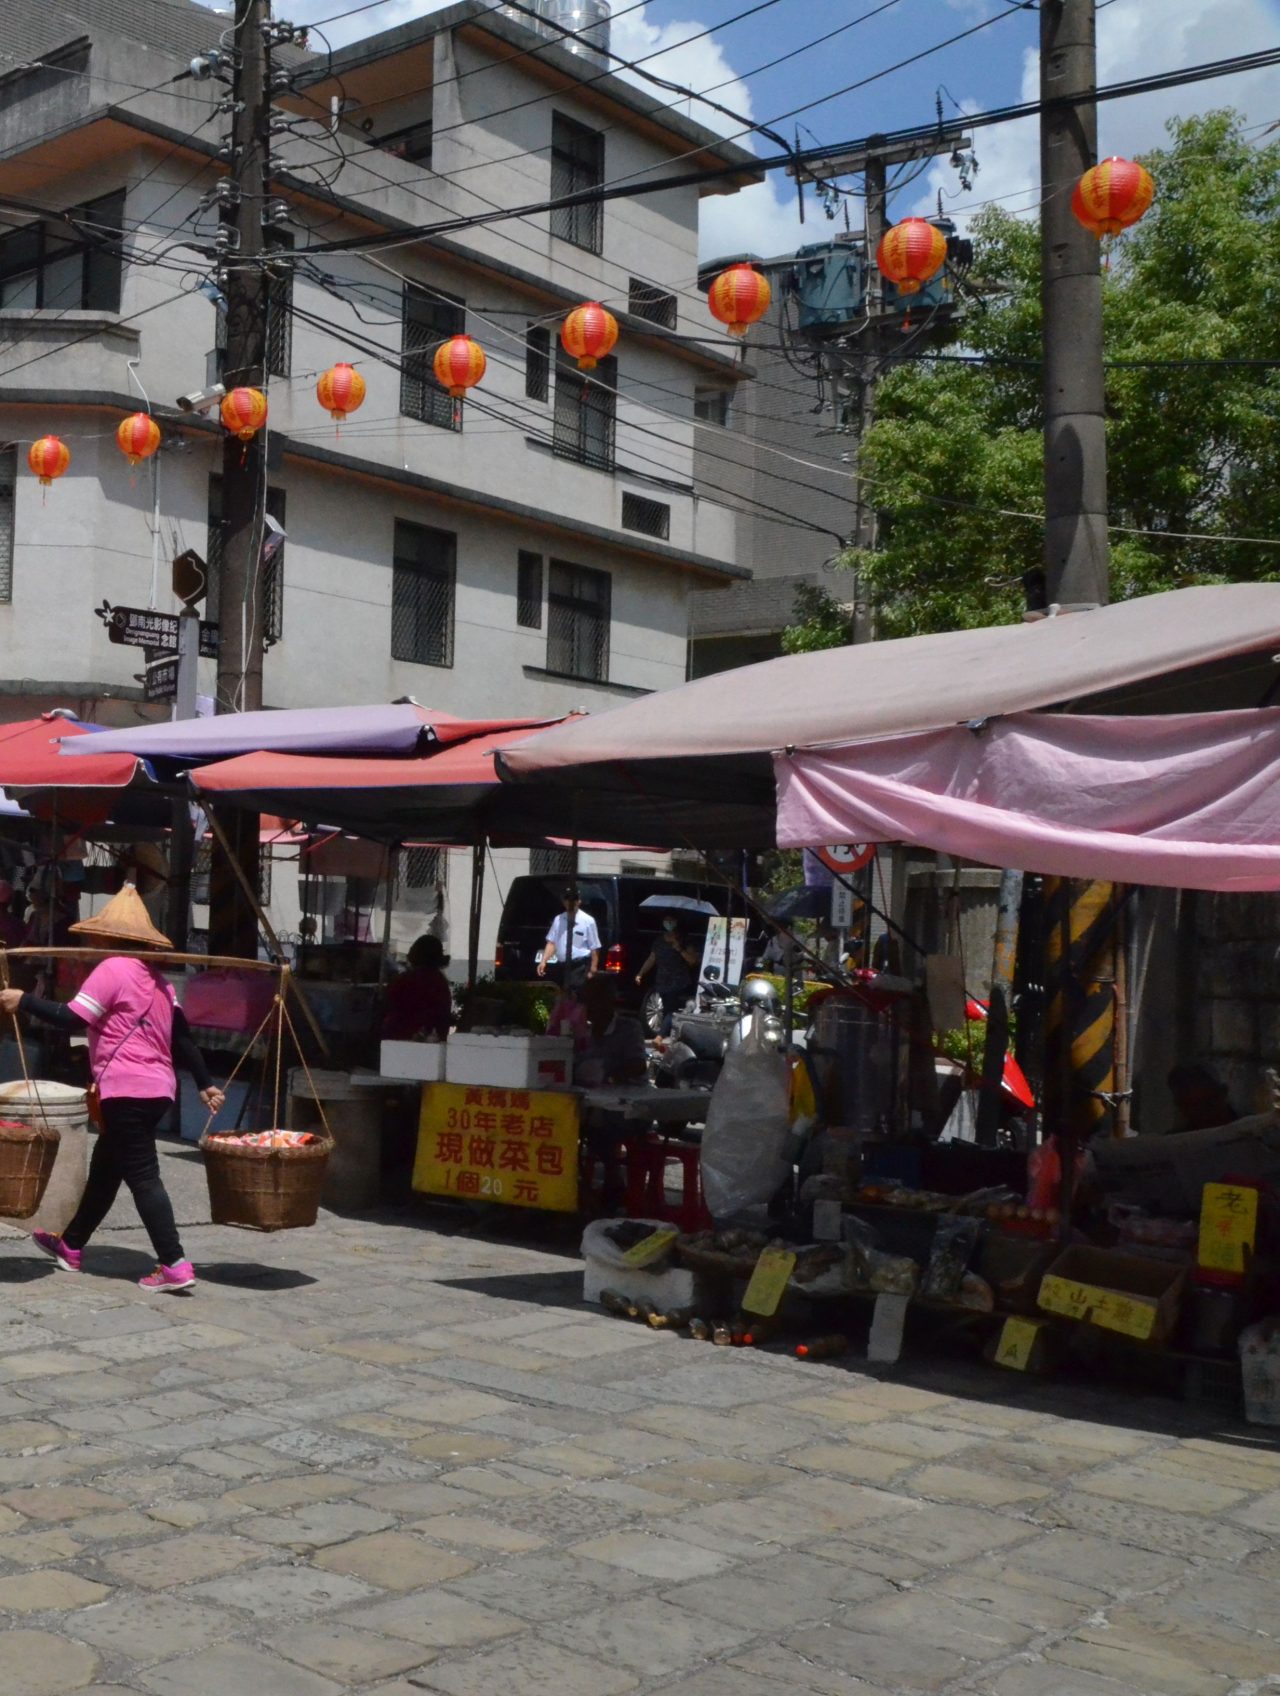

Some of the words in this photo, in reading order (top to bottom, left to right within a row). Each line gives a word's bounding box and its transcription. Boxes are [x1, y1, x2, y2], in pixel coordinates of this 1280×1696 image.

[447, 1107, 555, 1138] 30年老店
[434, 1131, 565, 1176] 現做菜包
